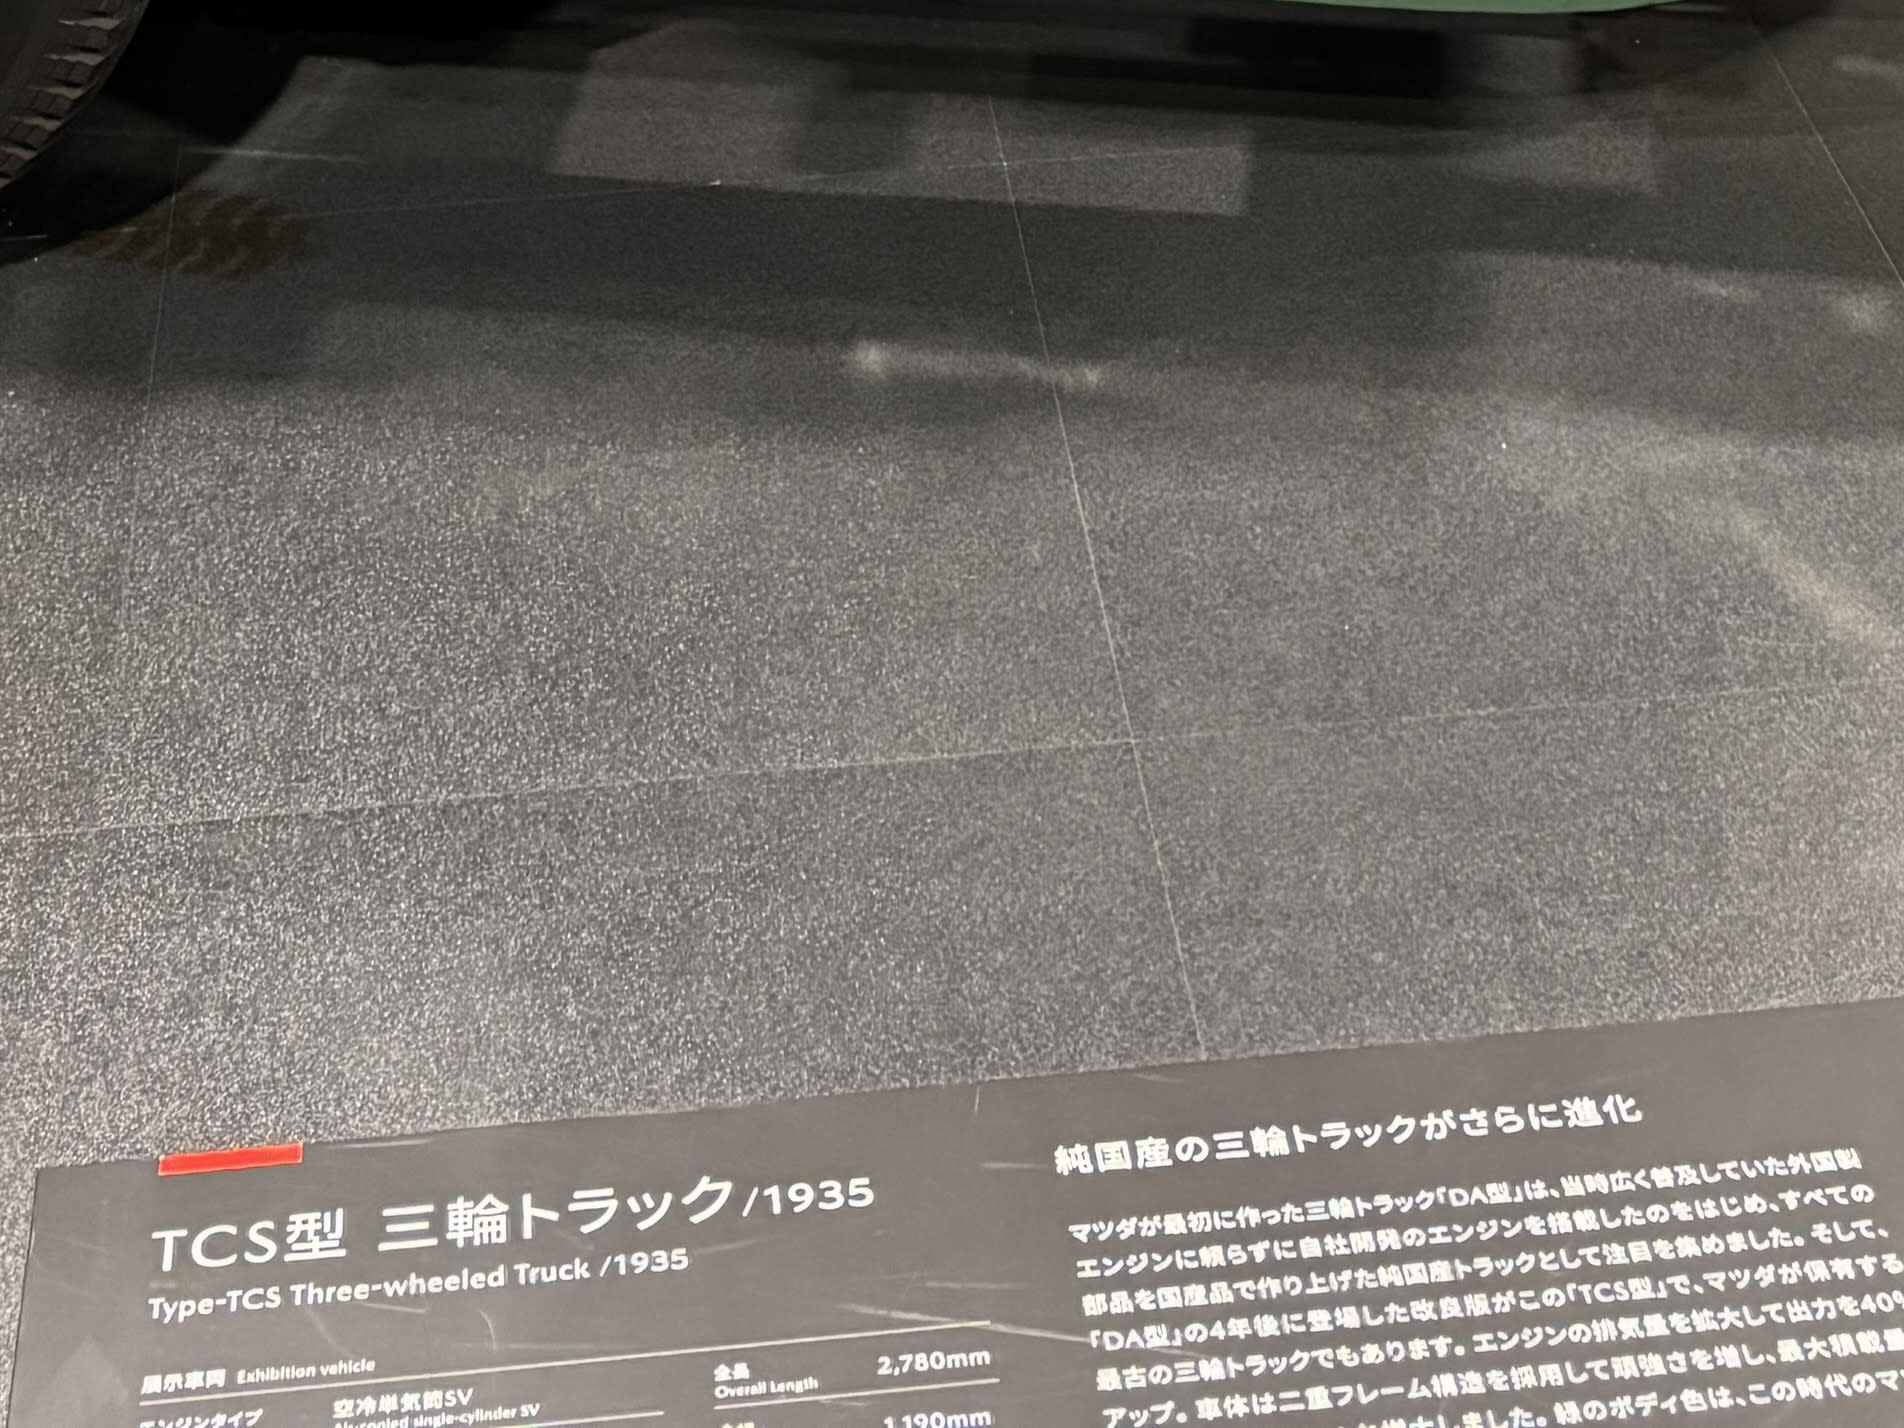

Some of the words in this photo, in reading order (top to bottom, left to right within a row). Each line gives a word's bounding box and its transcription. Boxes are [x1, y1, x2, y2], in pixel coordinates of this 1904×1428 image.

[1055, 1094, 1642, 1175] 純国産の三輪トラックがさらに進化
[152, 1208, 347, 1272] TCS型
[148, 1286, 282, 1324] Type-TCS
[289, 1264, 508, 1306] Three-wheeled
[513, 1257, 591, 1285] Truck
[599, 1247, 691, 1277] /1935
[877, 1350, 992, 1376] 2,780mm
[520, 1402, 540, 1417] SV
